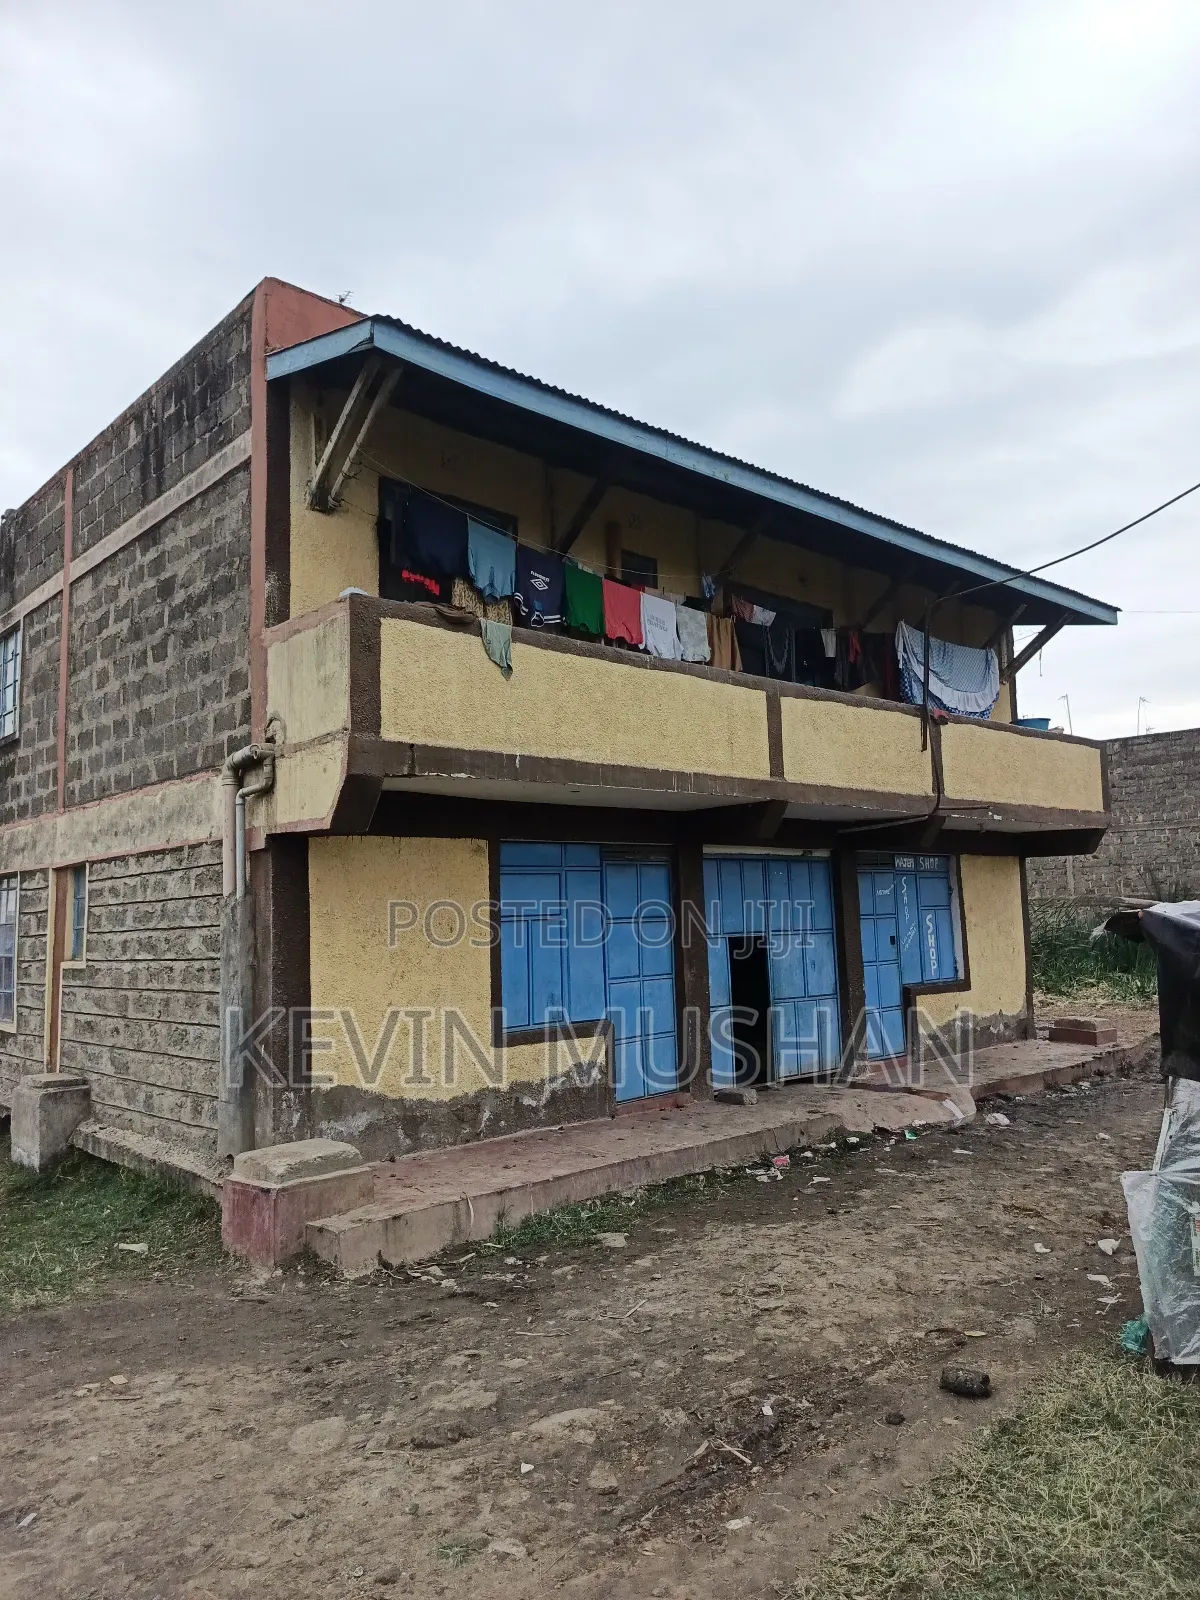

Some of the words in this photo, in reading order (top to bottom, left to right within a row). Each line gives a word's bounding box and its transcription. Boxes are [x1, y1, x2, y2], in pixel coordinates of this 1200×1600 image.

[919, 856, 939, 870] SHOP
[901, 876, 910, 924] SHOP
[925, 913, 938, 976] SHOP
